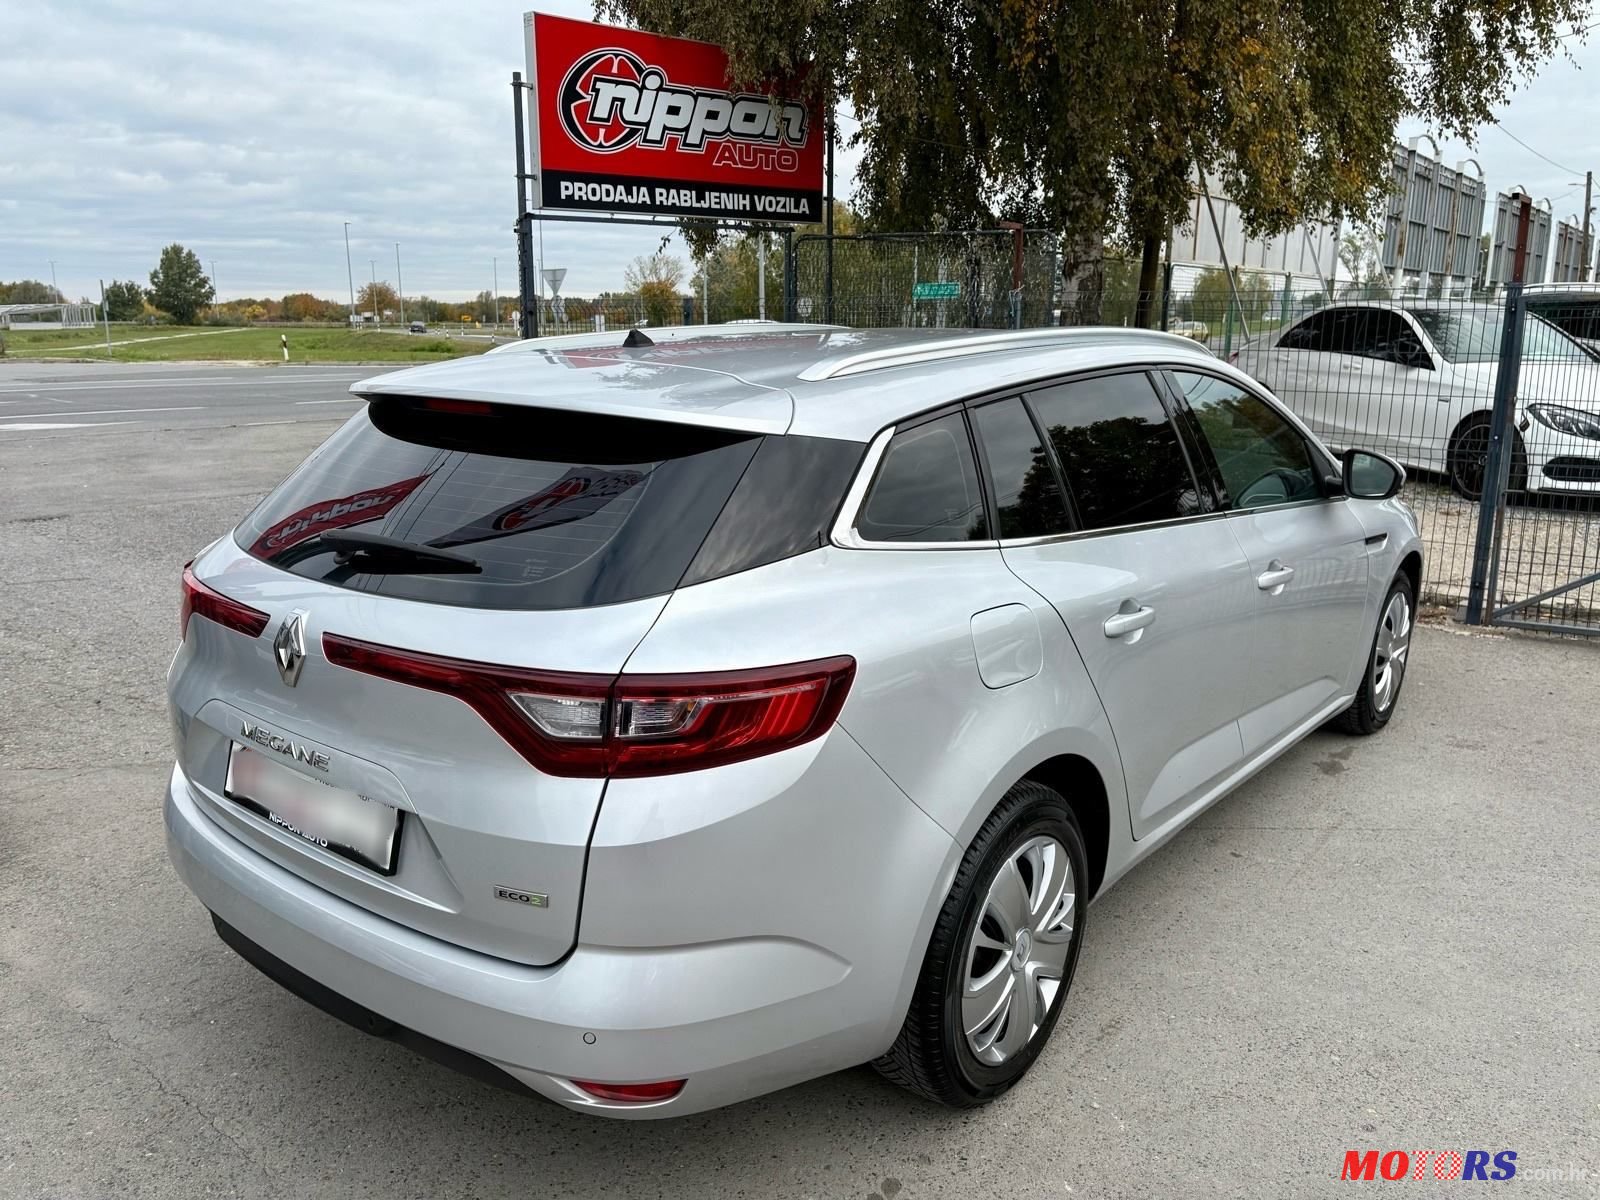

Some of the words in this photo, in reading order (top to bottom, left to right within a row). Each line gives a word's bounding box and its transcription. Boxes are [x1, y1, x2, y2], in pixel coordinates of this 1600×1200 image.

[590, 72, 807, 146] nippon
[712, 142, 799, 173] AUTO
[560, 180, 651, 205] PRODAJA
[655, 187, 751, 212] RABLJENIH
[753, 195, 810, 215] VOZILA
[239, 720, 331, 773] MEGANE
